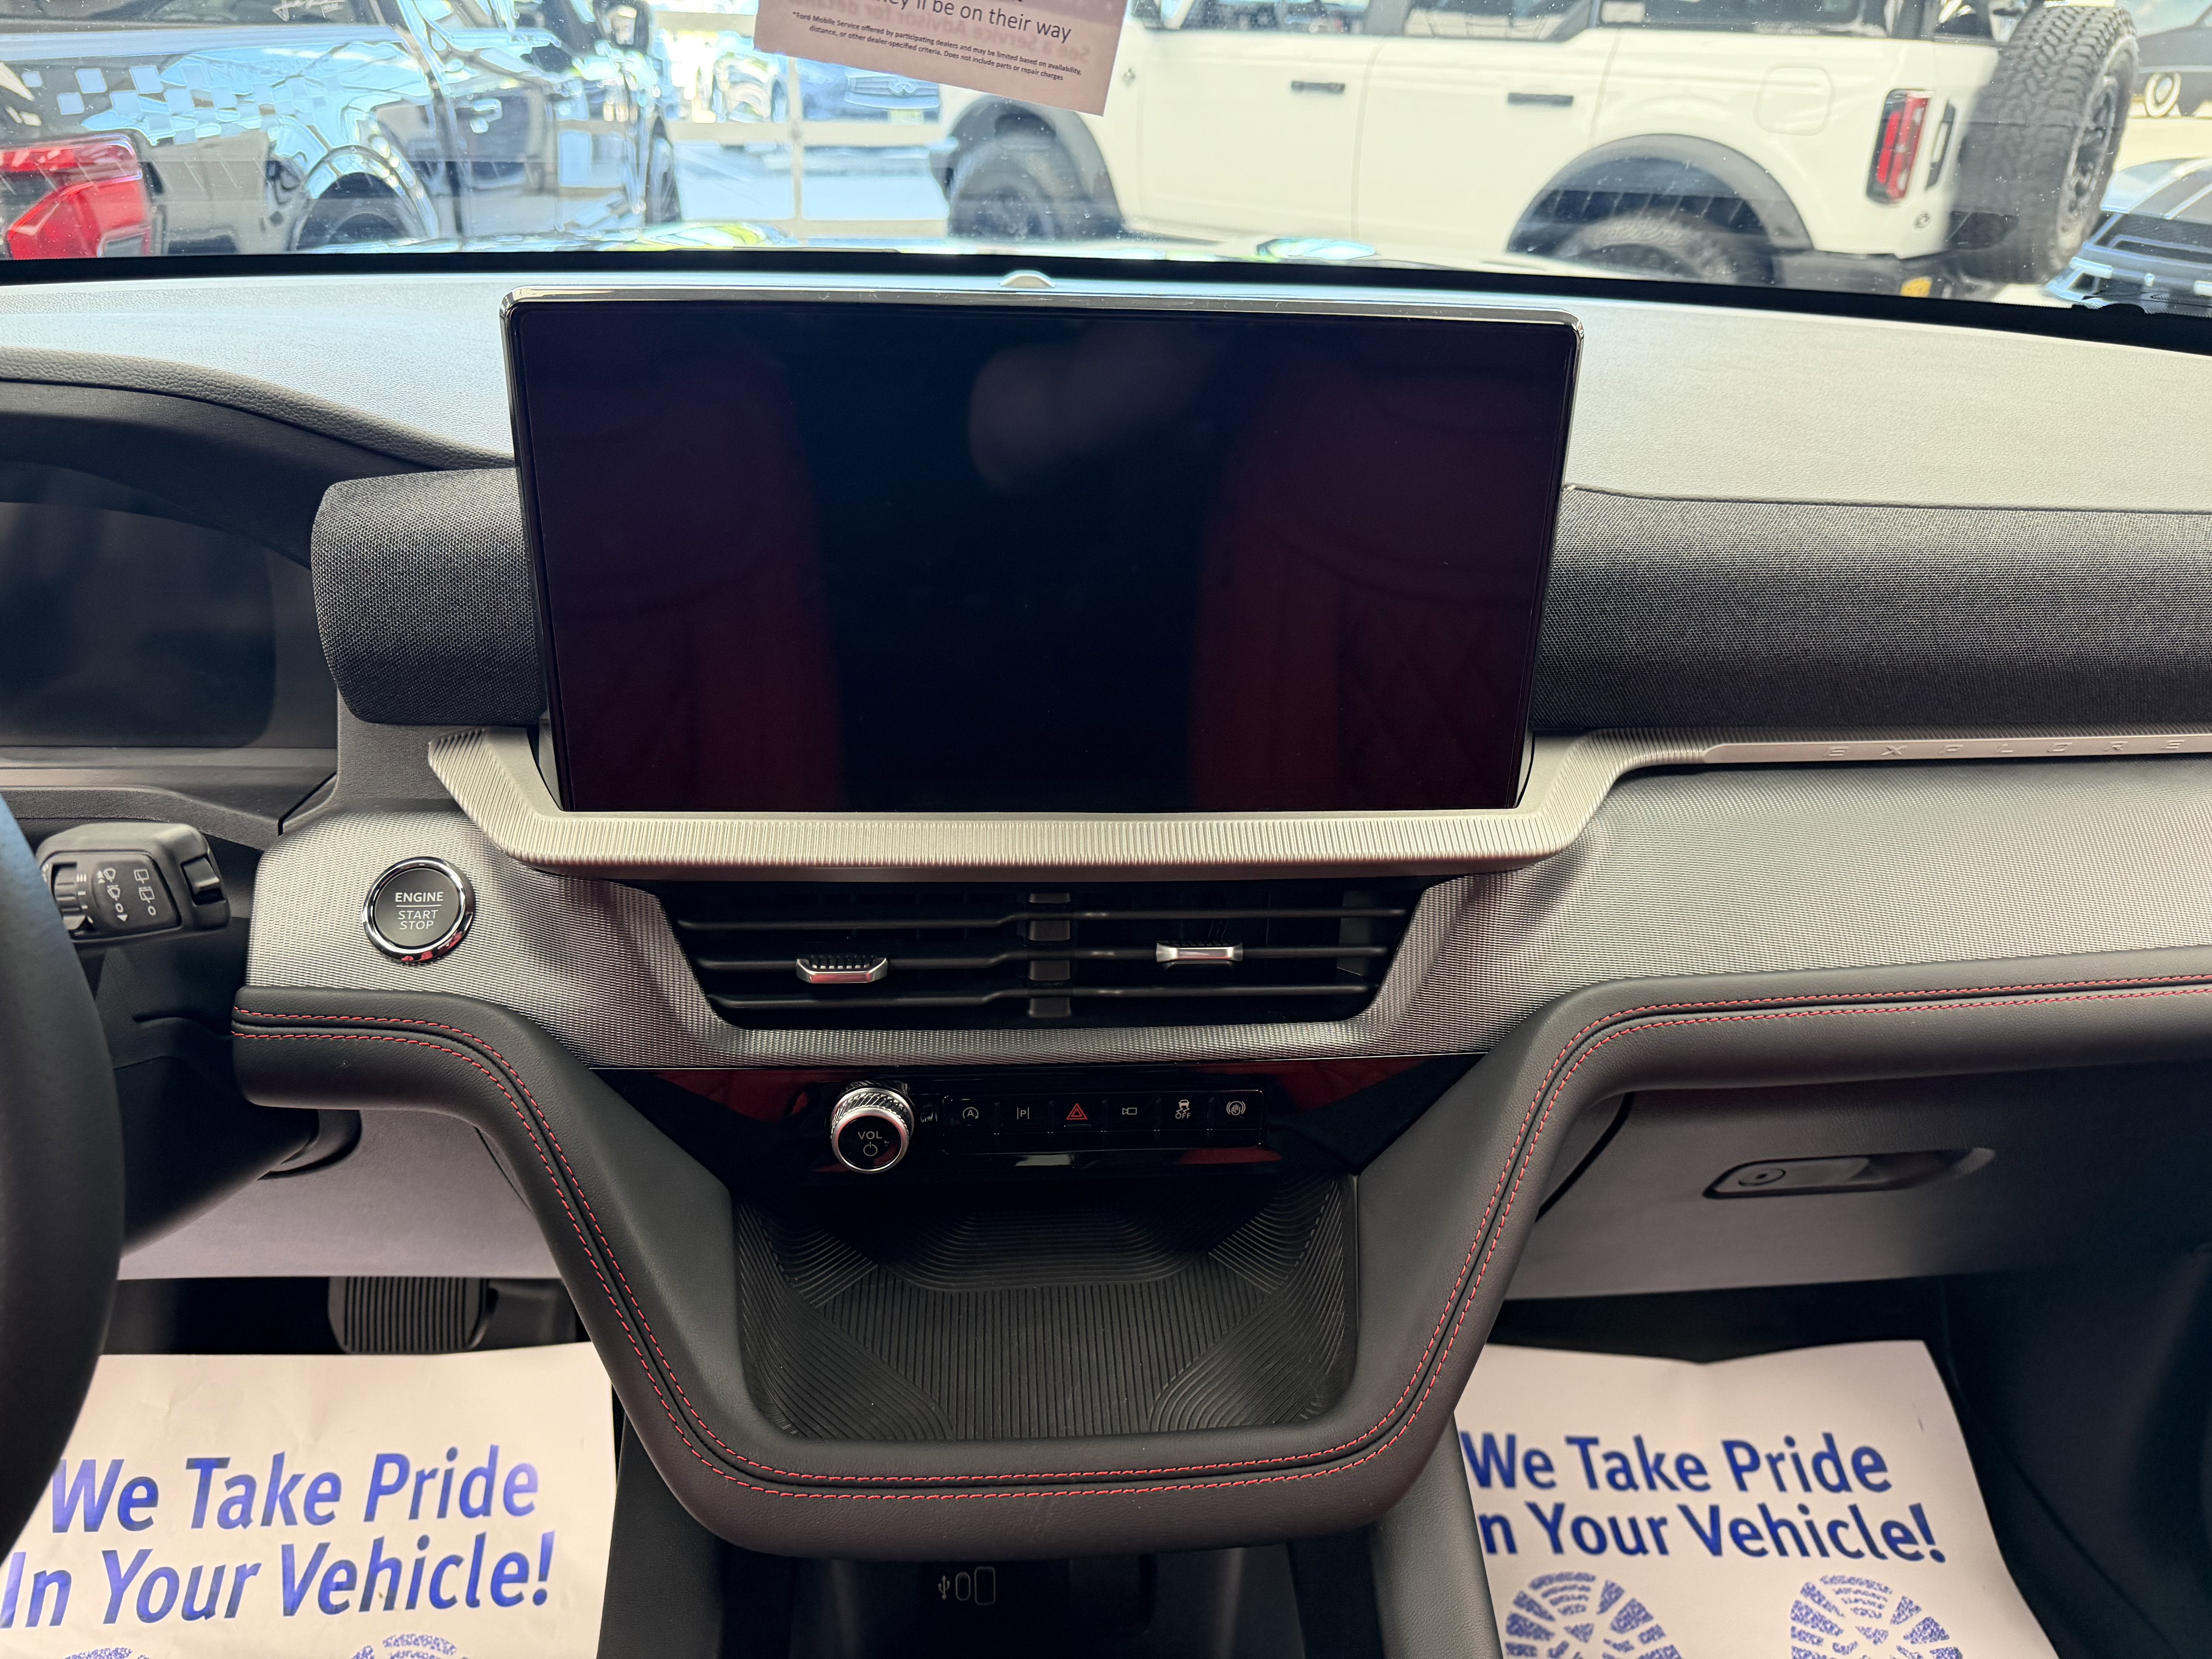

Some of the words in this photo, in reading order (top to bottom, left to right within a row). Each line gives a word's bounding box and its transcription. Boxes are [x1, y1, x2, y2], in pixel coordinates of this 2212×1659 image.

[813, 15, 835, 25] Mobile
[837, 20, 859, 30] Service
[861, 25, 884, 34] offered
[895, 33, 934, 45] participating
[936, 40, 958, 49] dealers
[997, 52, 1018, 61] limited
[1020, 56, 1037, 65] based
[1048, 64, 1082, 76] availability,
[933, 0, 955, 15] be
[960, 5, 982, 21] on
[989, 8, 1032, 31] their
[1036, 21, 1072, 44] way
[809, 25, 837, 37] distance,
[867, 36, 917, 51] dealer-specified
[919, 46, 942, 56] criteria.
[972, 57, 995, 66] include
[1021, 67, 1039, 75] repair
[1041, 71, 1063, 81] charges
[395, 891, 444, 902] ENGINE
[398, 910, 439, 920] START
[399, 920, 434, 930] STOP
[857, 1130, 883, 1140] VOL
[52, 1460, 159, 1534] We
[186, 1452, 342, 1530] Take
[364, 1444, 538, 1522] Pride
[1460, 1432, 1557, 1489] We
[1565, 1435, 1711, 1492] Take
[1721, 1432, 1893, 1493] Pride
[1479, 1515, 1517, 1554] n
[1525, 1501, 1669, 1556] Your
[1677, 1503, 1946, 1563] Vehicle!
[0, 1552, 72, 1629] In
[102, 1549, 262, 1625] Your
[282, 1531, 555, 1617] Vehicle!
